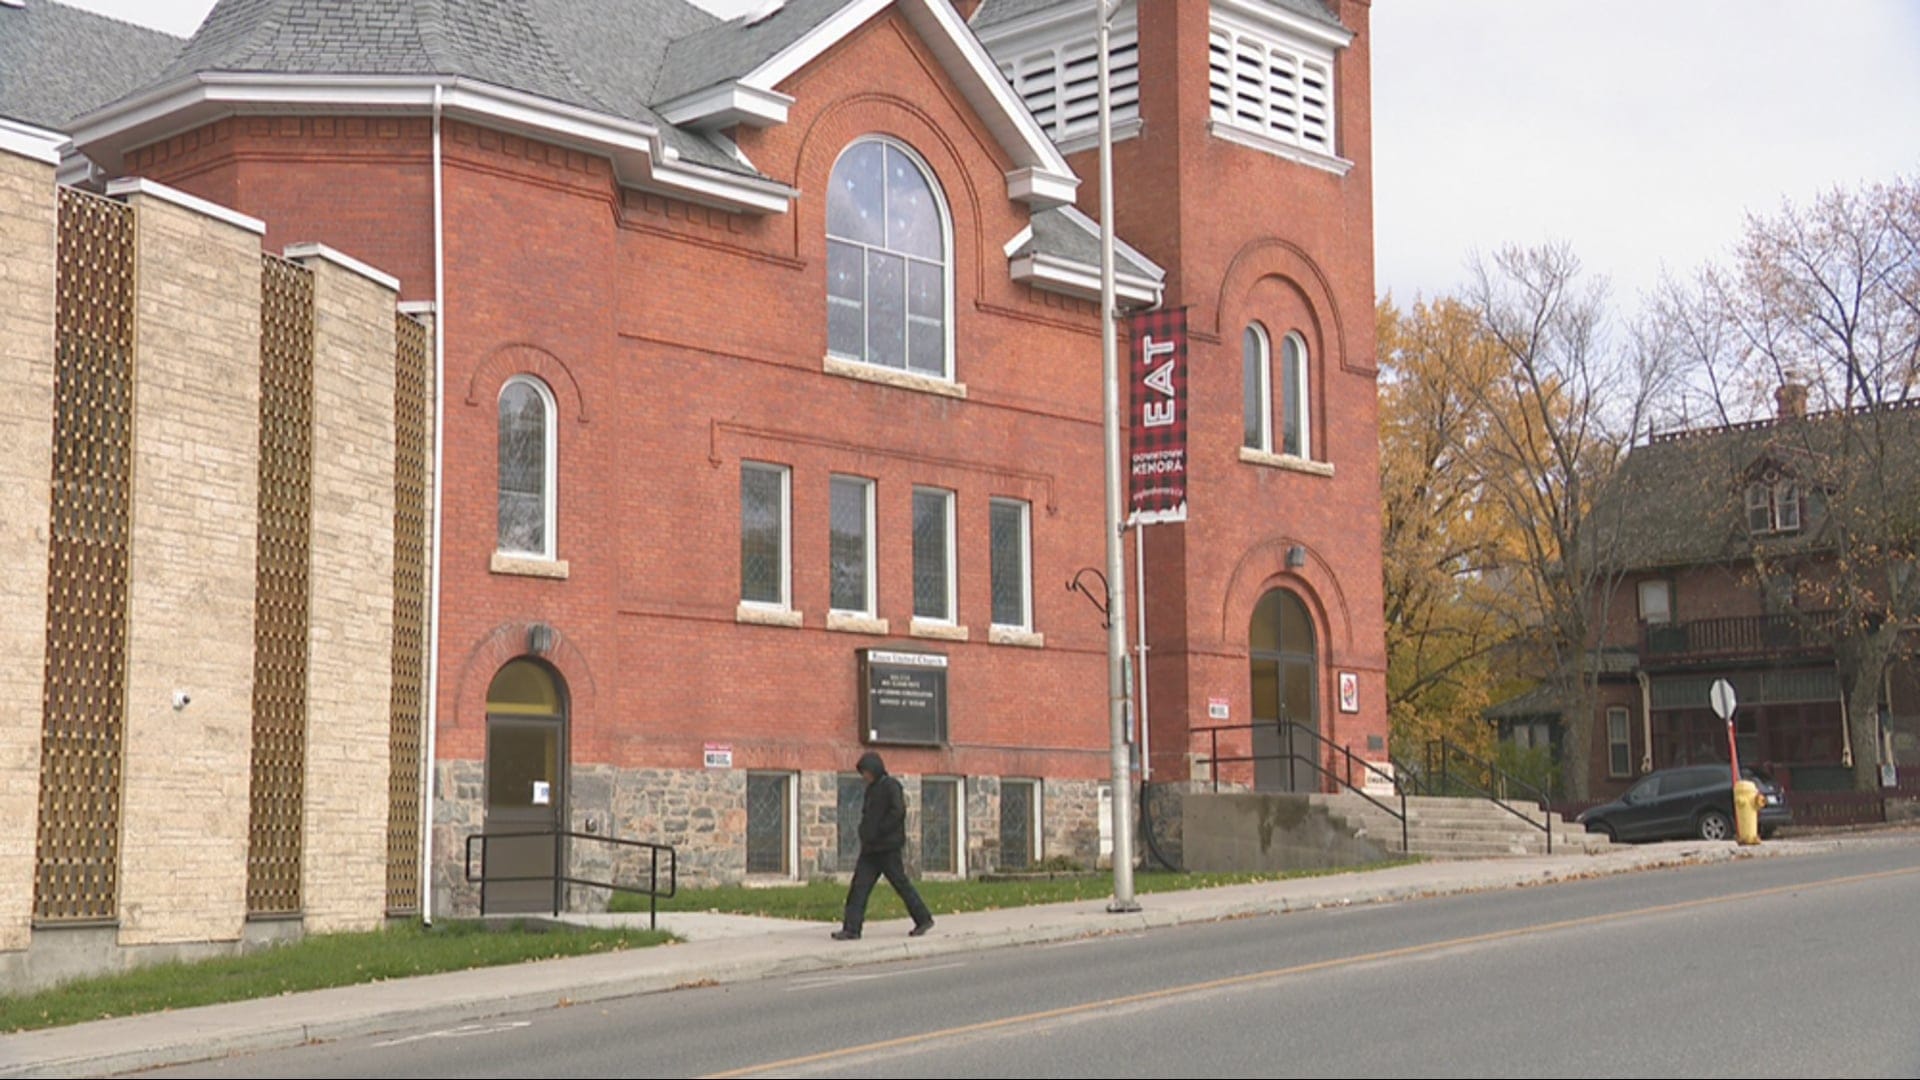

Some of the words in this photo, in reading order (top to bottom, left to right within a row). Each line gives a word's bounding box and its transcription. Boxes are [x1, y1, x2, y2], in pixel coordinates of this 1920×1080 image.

[1143, 335, 1175, 428] EAT
[1132, 449, 1184, 461] DOWNTOWN
[1132, 459, 1184, 475] KENORA
[917, 654, 943, 666] Church
